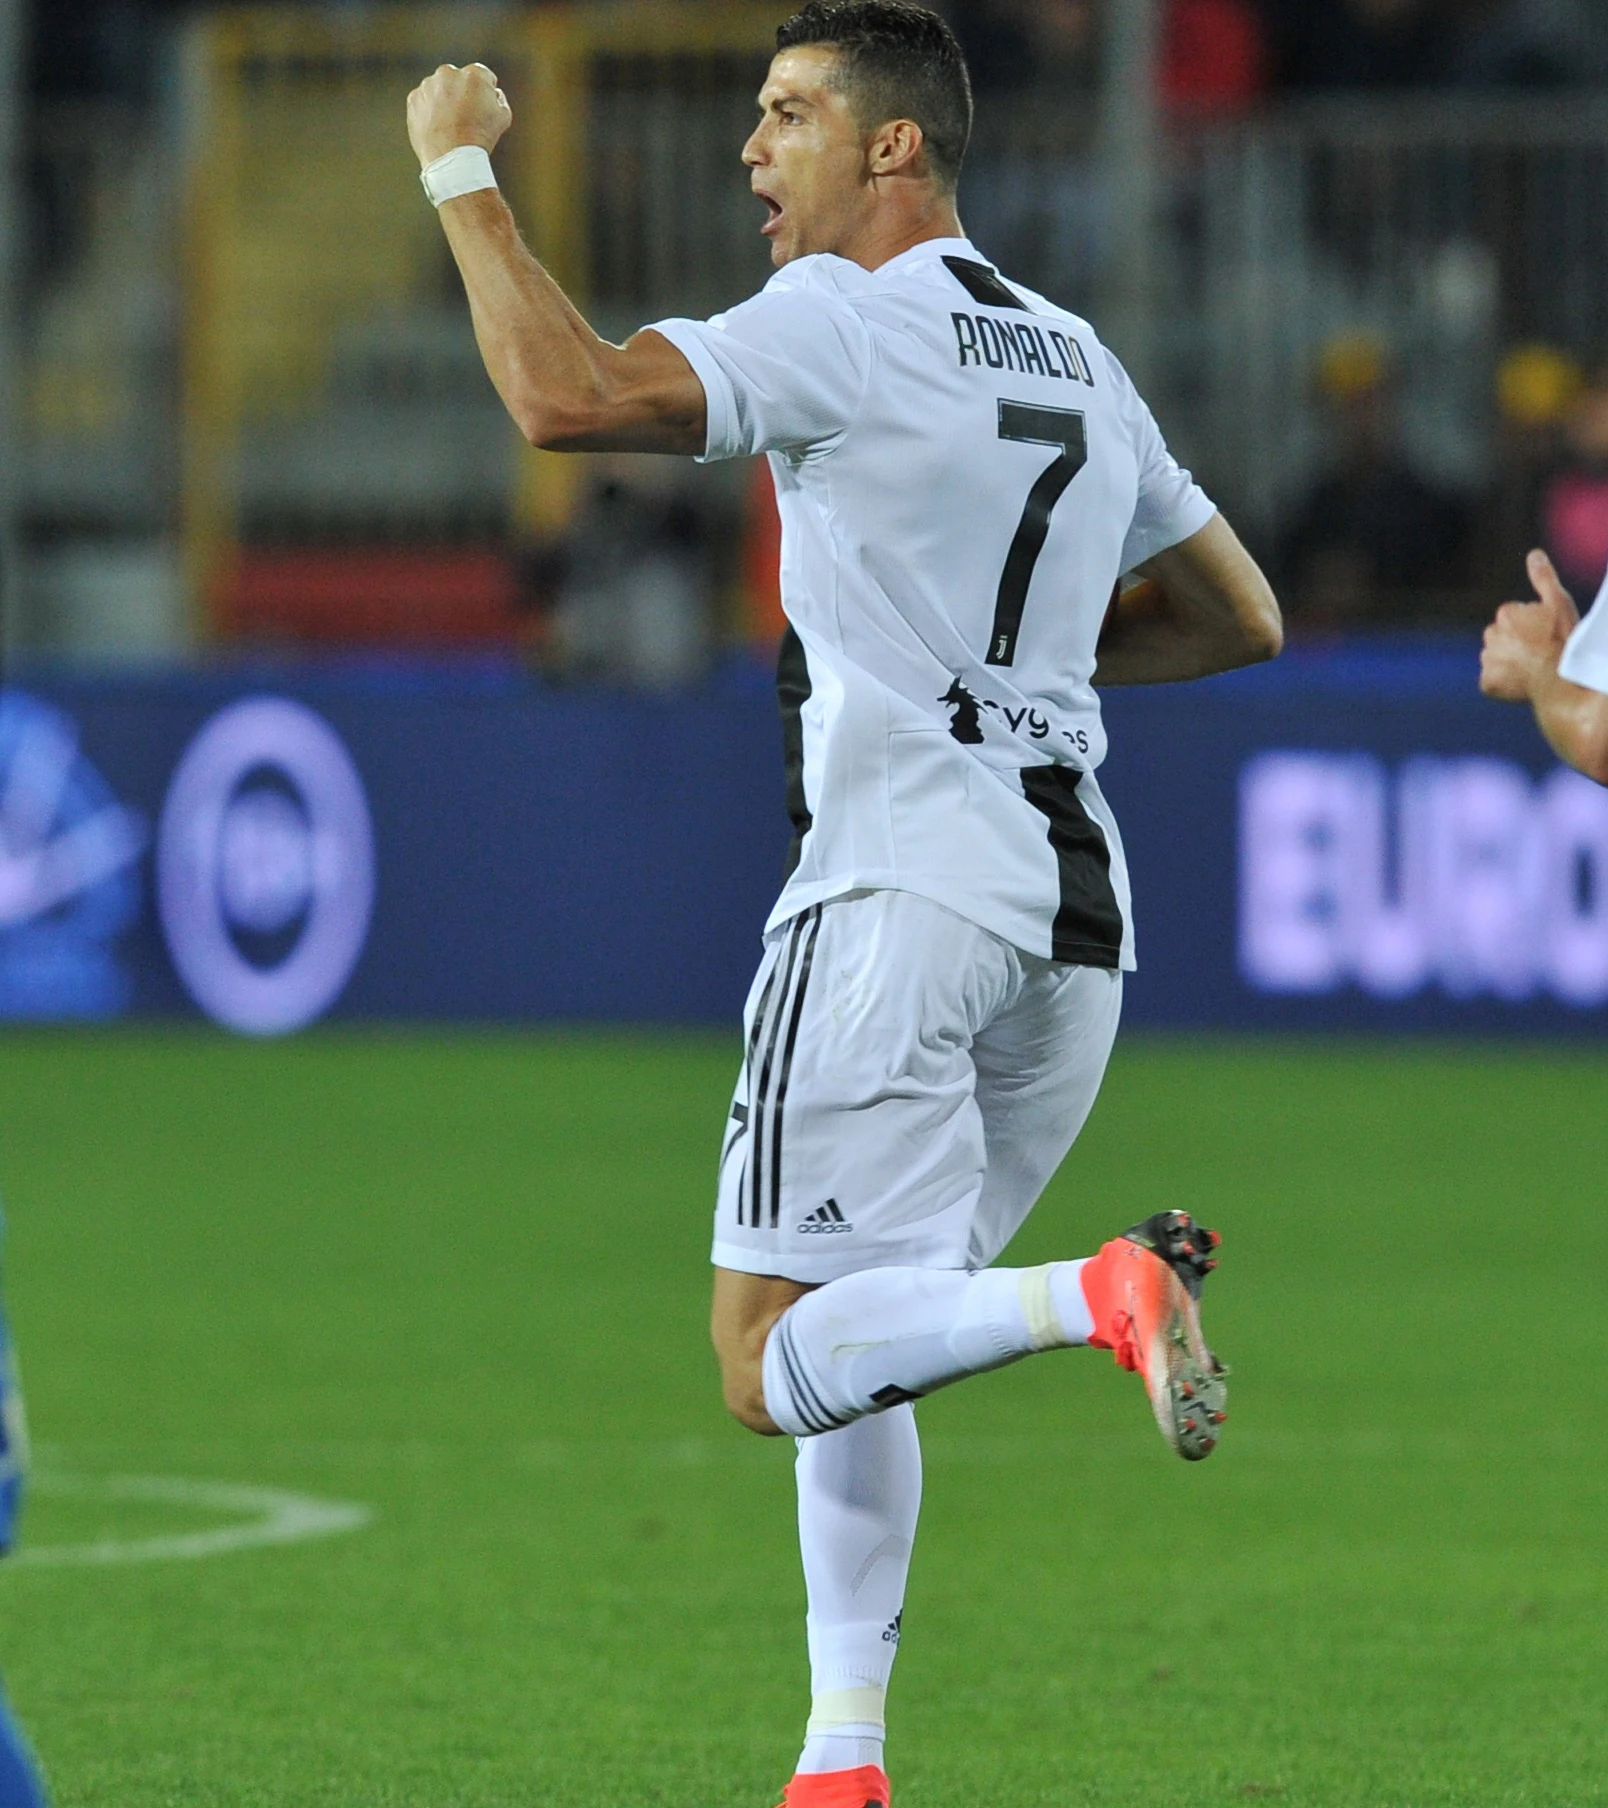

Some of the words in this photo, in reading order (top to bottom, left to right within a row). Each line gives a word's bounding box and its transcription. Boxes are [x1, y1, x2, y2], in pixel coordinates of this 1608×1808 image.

[950, 311, 1095, 388] RONALDO
[985, 397, 1088, 668] 7
[797, 1222, 853, 1234] adidas
